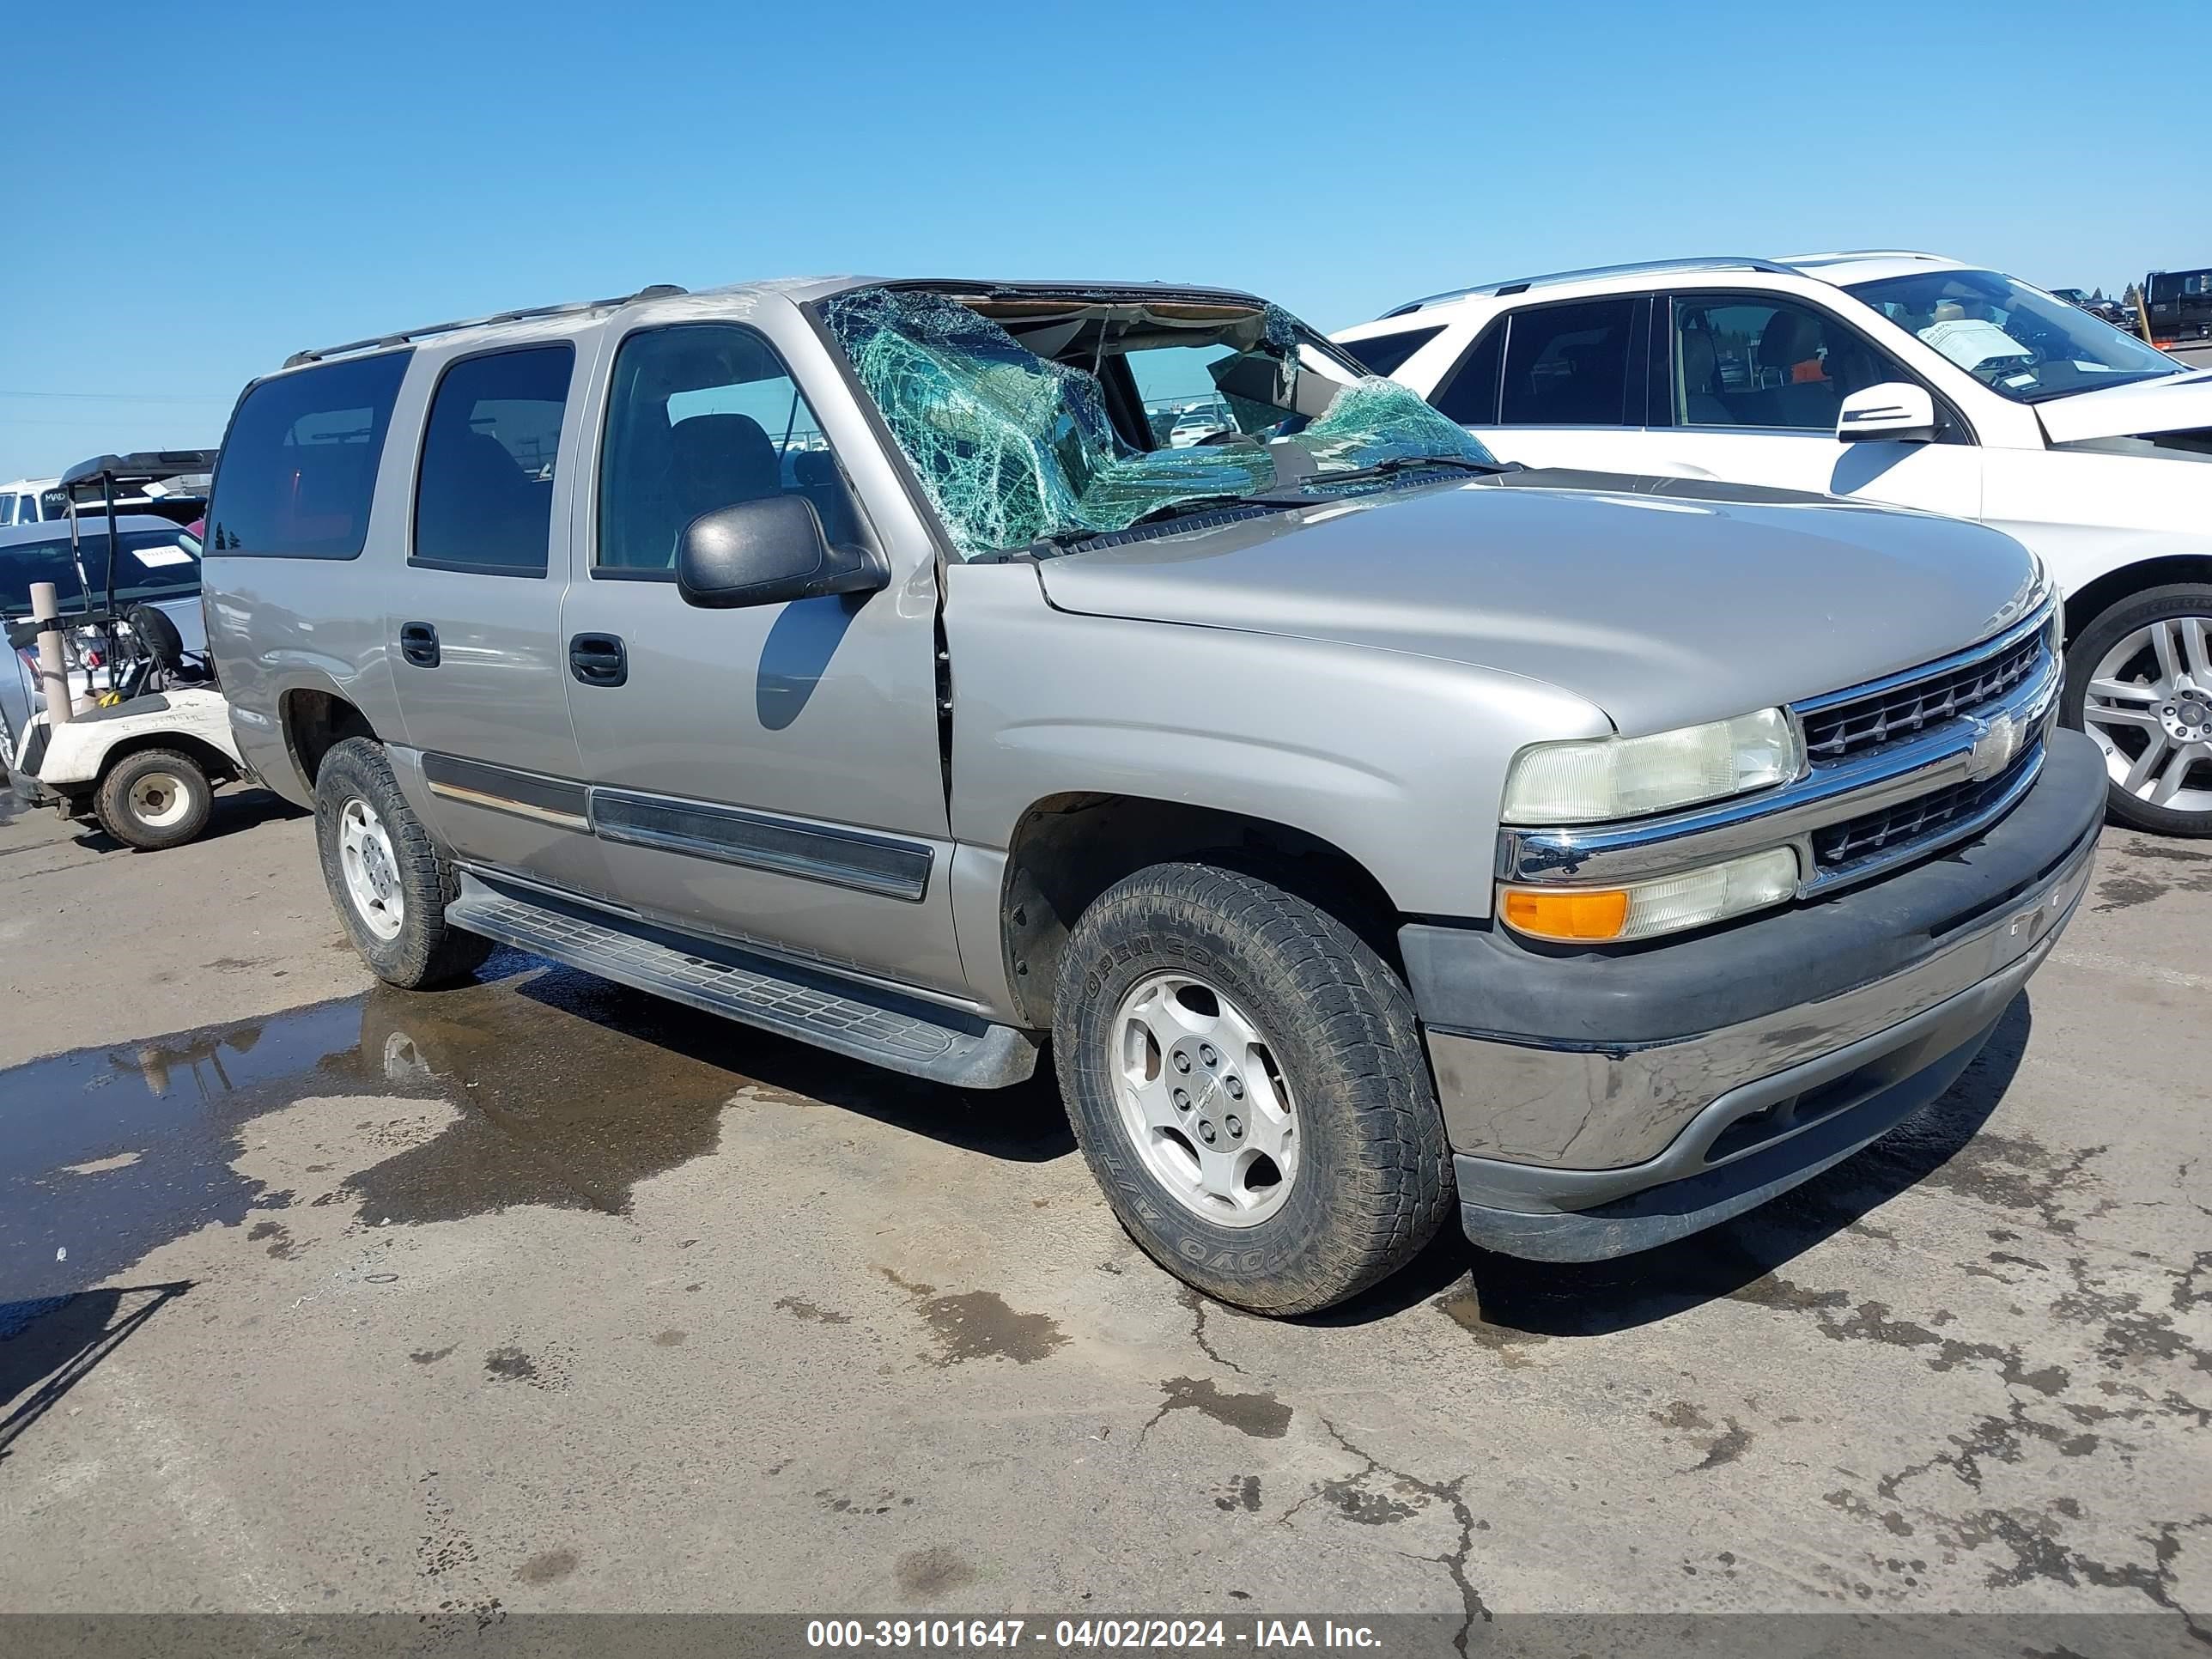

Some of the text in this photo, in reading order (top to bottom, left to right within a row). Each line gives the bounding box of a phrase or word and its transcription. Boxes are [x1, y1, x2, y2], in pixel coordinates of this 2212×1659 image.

[45, 493, 65, 502] MAD
[1085, 933, 1153, 1000] OPEN
[1100, 1153, 1164, 1221] A/T
[1177, 1231, 1294, 1274] TOYO
